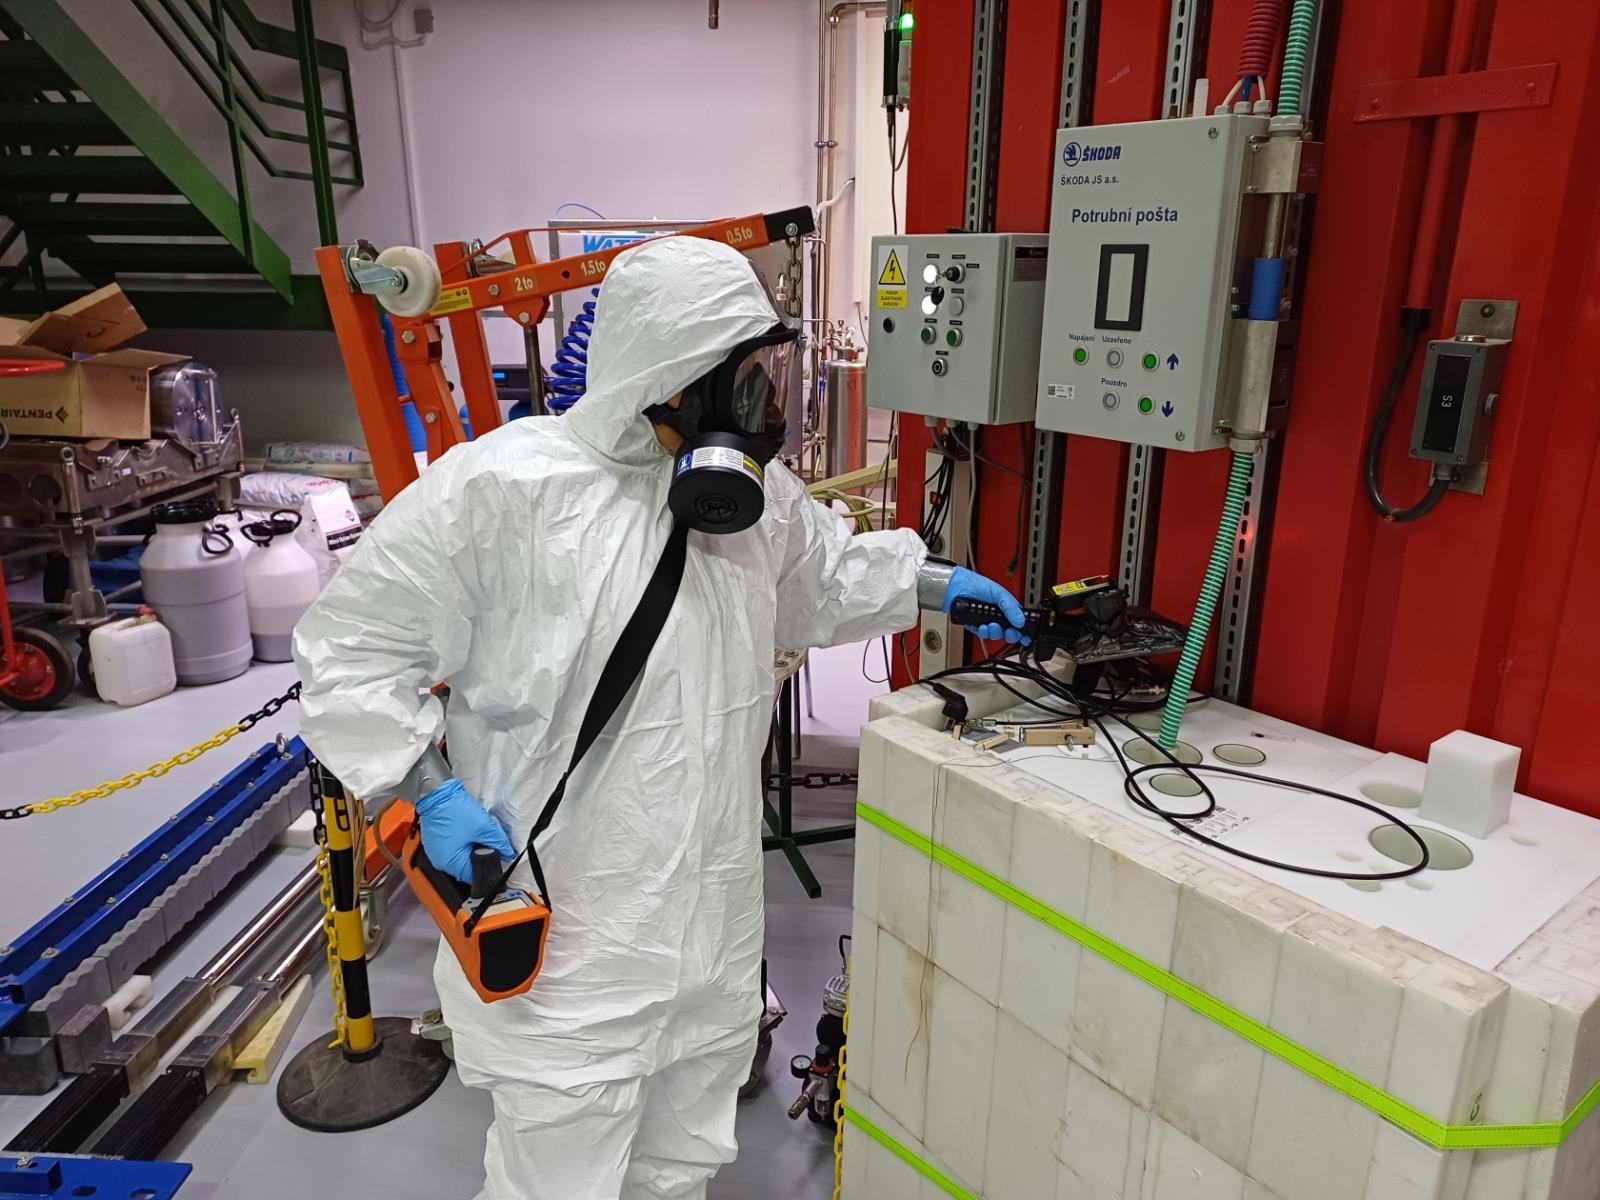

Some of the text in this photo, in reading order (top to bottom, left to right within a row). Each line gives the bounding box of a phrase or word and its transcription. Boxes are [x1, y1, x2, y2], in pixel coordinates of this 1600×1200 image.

[1061, 174, 1089, 186] ŠKODA
[1105, 175, 1119, 184] a.s.
[1072, 206, 1178, 225] Potrubní pošta
[1101, 377, 1128, 388] Pouzdro
[1441, 394, 1454, 408] S3
[1, 408, 53, 419] PENTAIR
